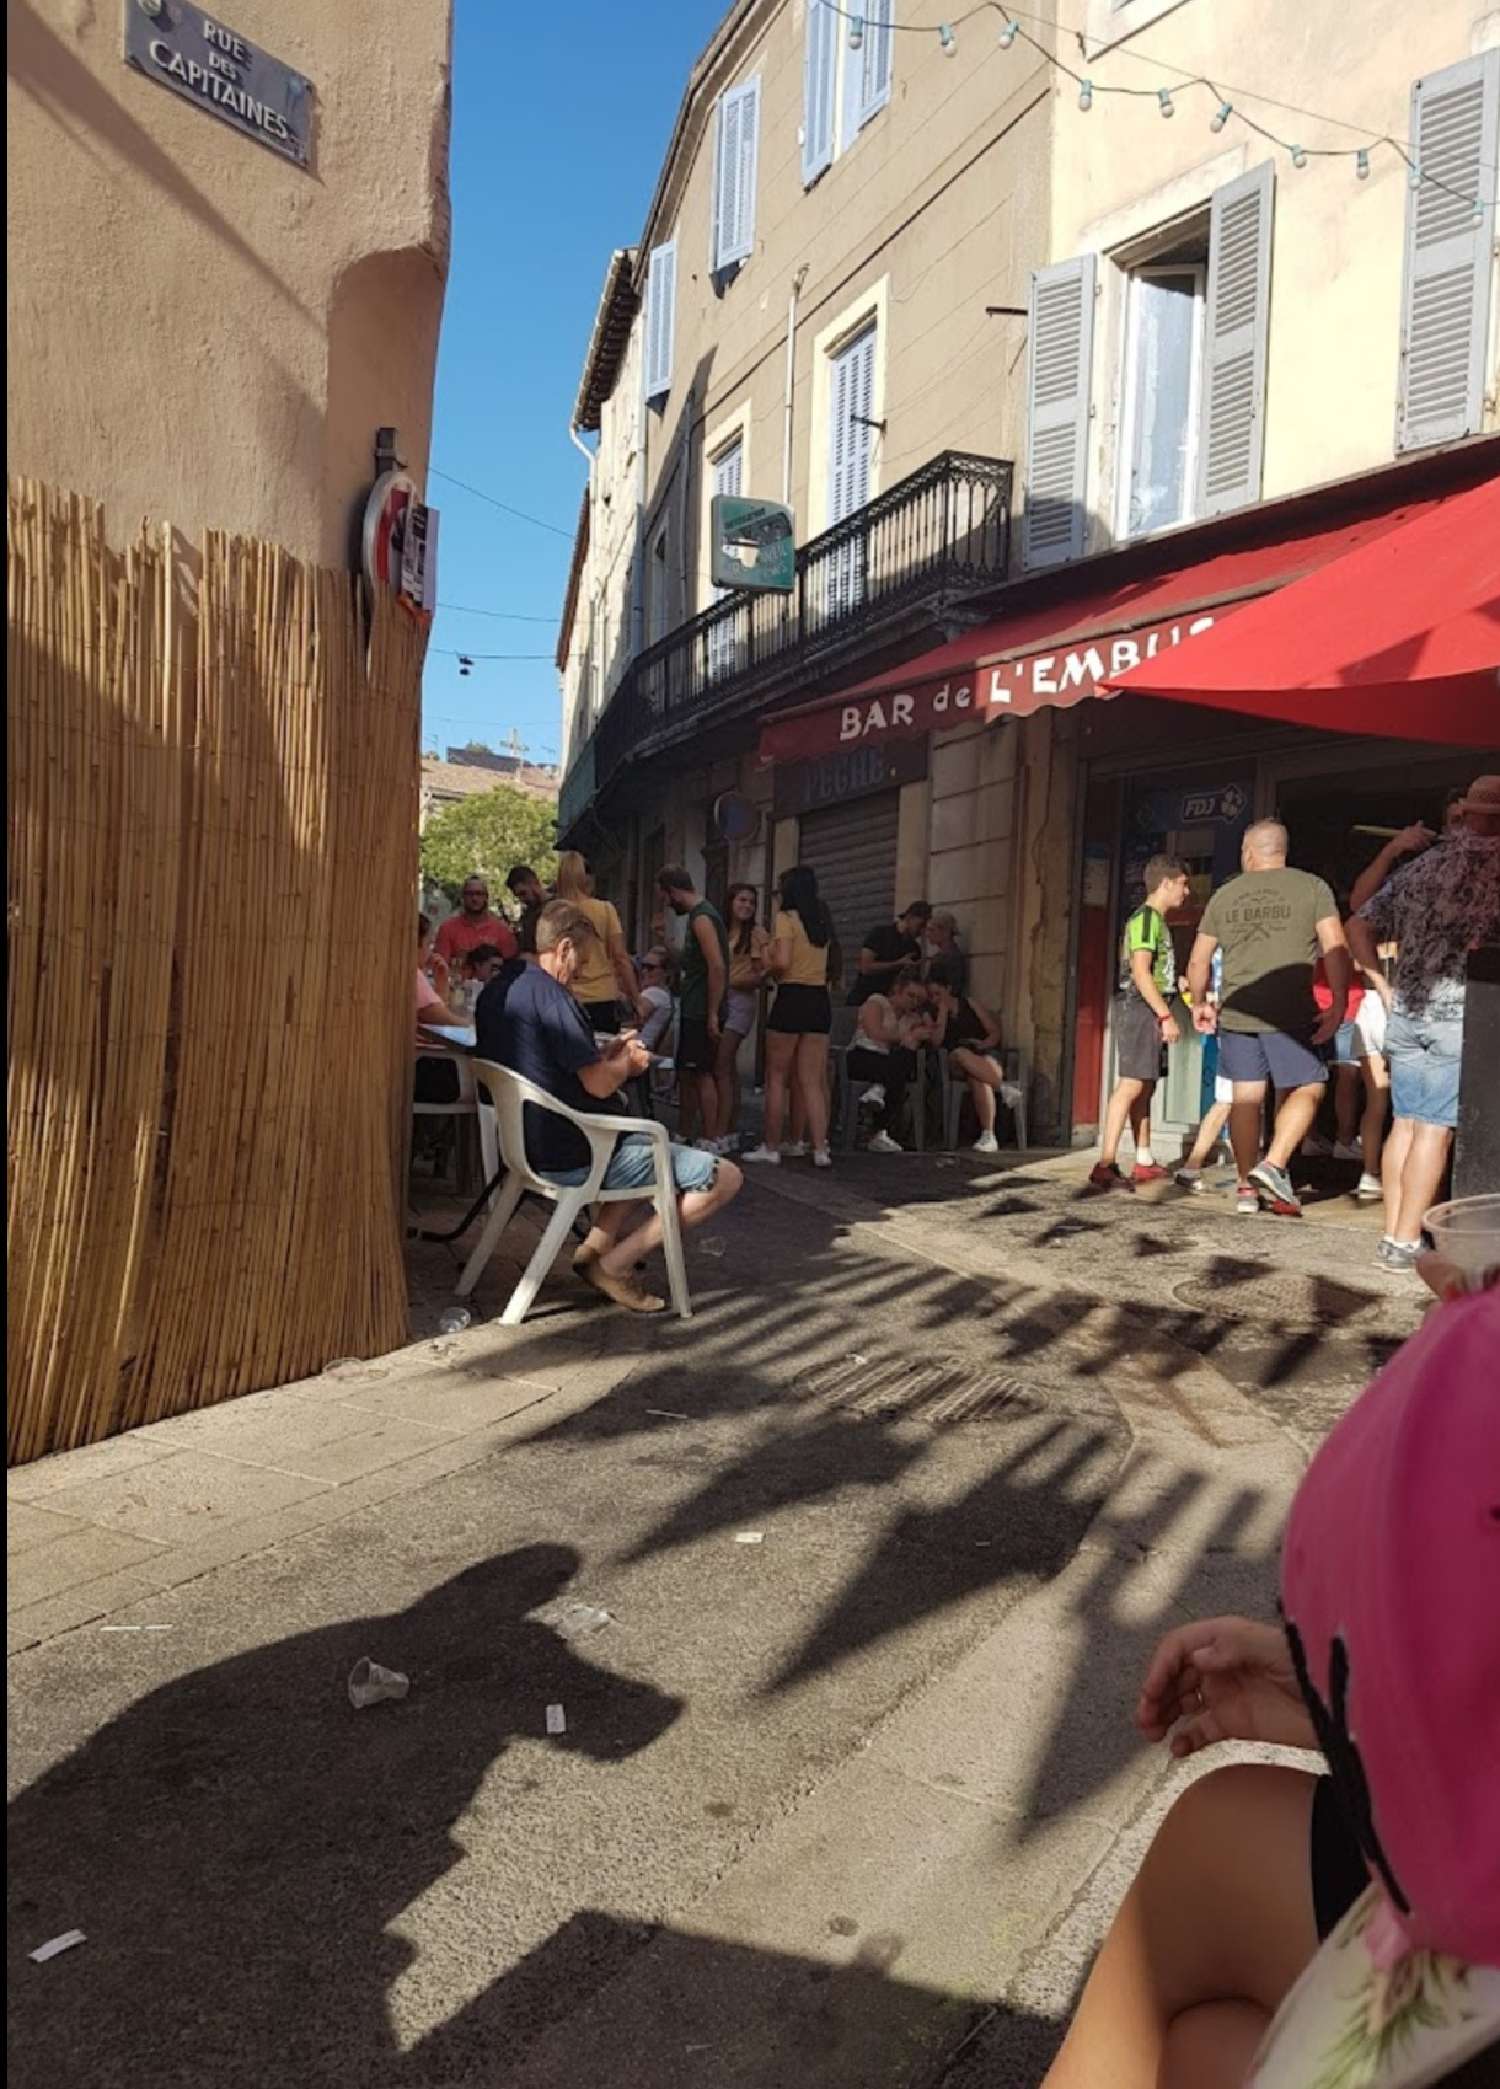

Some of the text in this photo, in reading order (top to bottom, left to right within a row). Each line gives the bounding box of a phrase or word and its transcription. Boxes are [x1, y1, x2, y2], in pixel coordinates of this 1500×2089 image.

[203, 20, 247, 60] RUE
[208, 51, 236, 80] DES
[149, 40, 289, 139] CAPITAINES
[839, 692, 914, 742] BAR
[932, 683, 972, 713] de
[1184, 798, 1217, 818] FDJ
[1225, 909, 1240, 924] LE
